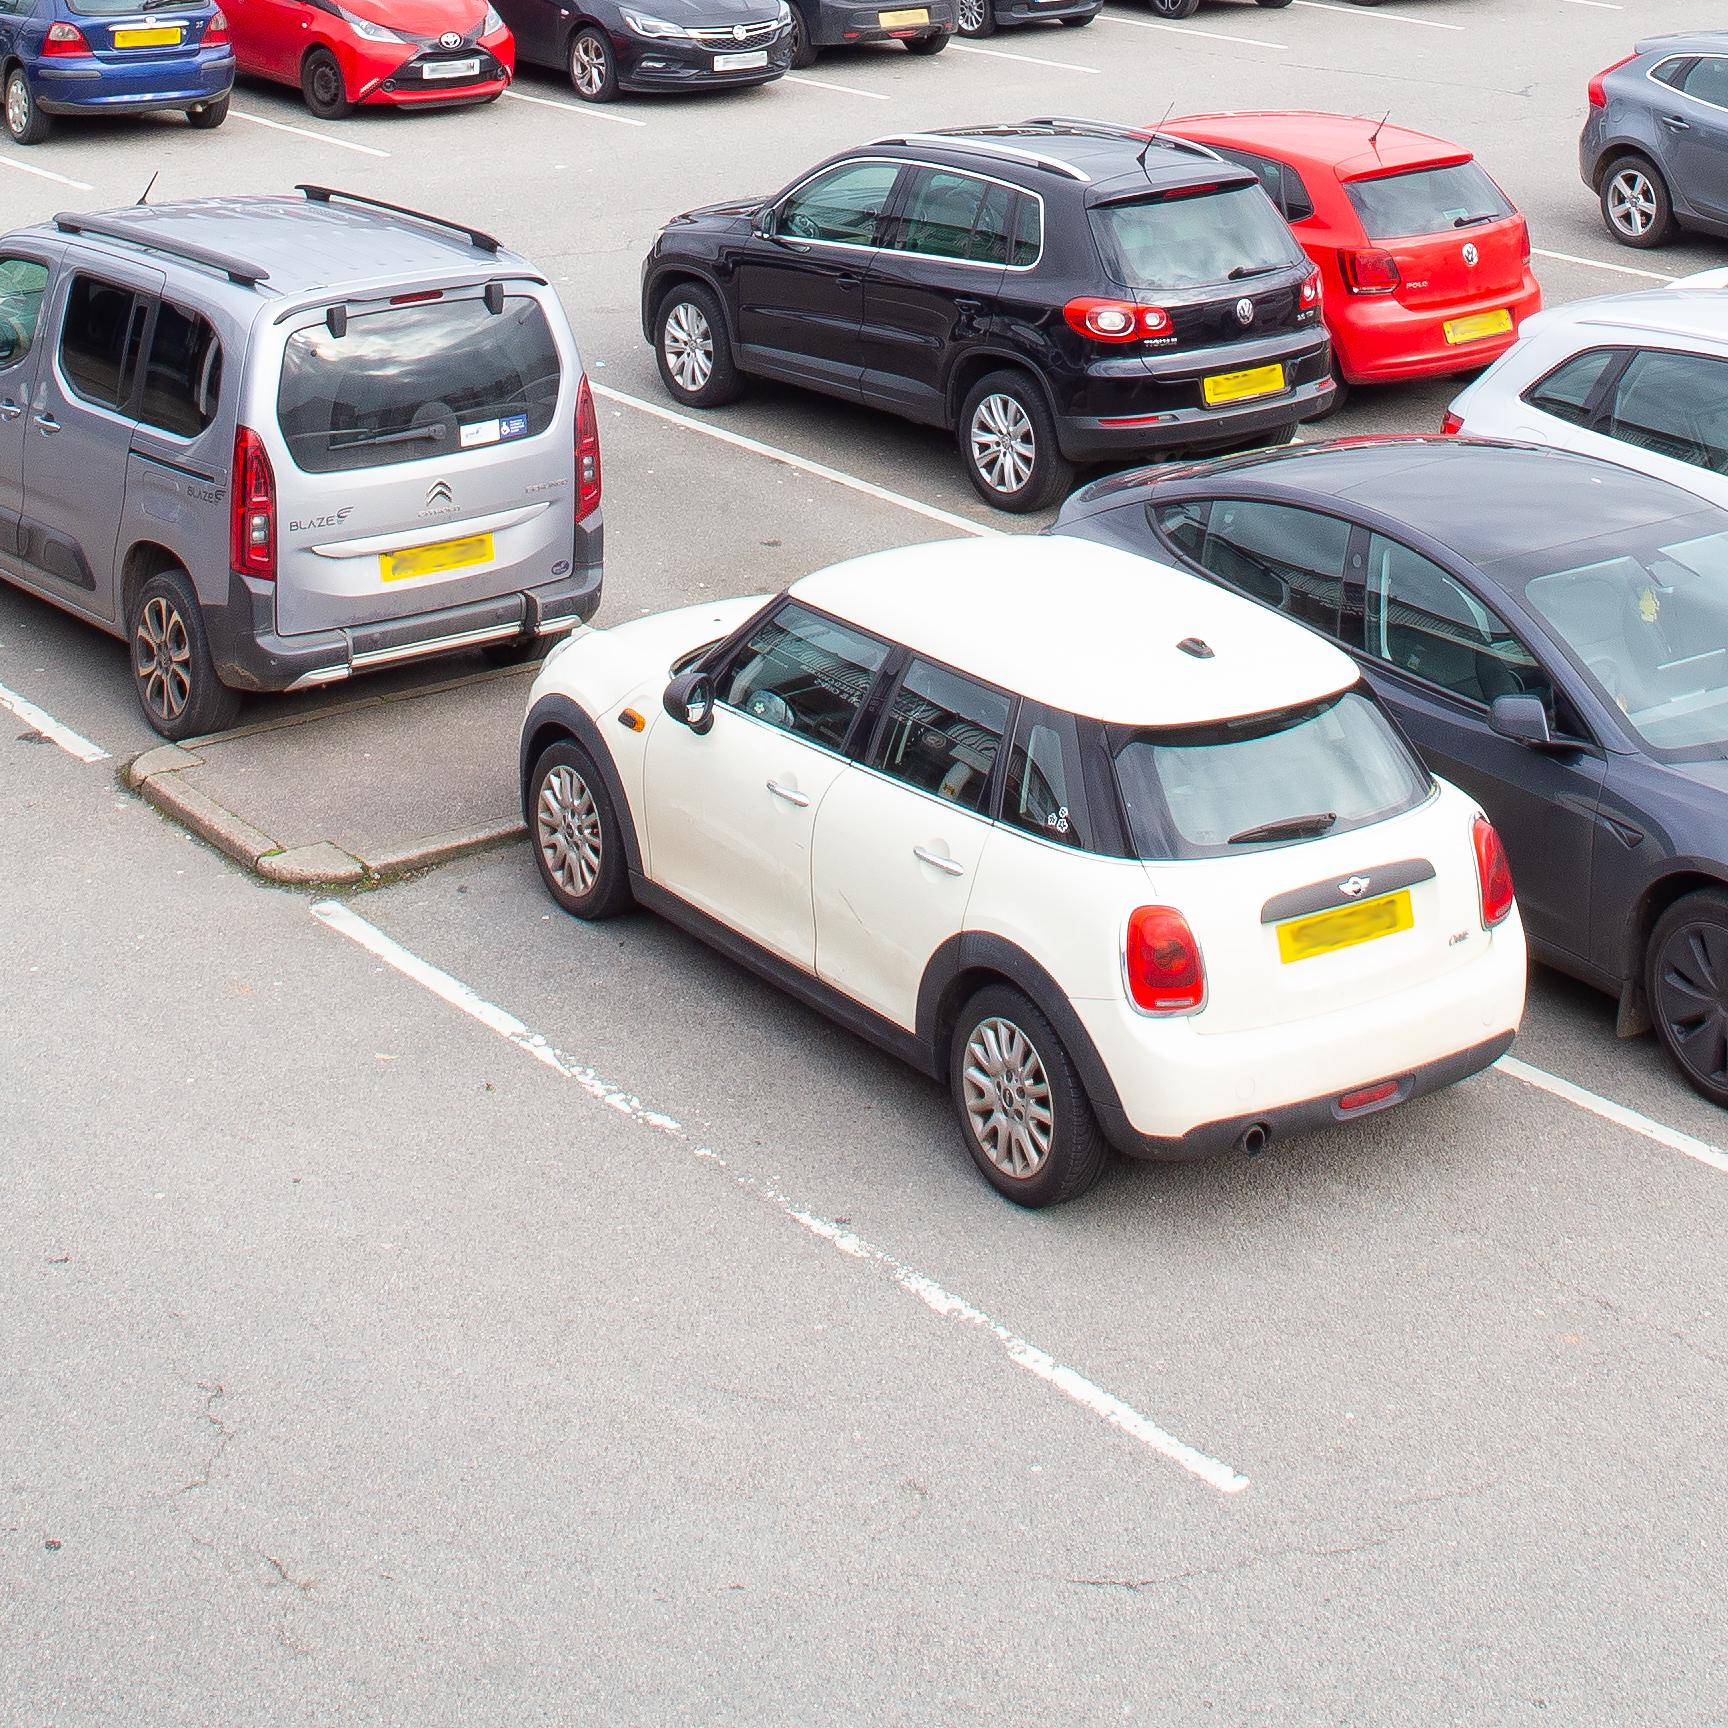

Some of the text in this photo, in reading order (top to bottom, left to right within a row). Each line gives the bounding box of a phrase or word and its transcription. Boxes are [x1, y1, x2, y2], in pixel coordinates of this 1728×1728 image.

[1405, 280, 1429, 289] POLO
[187, 486, 215, 503] BLAZE
[289, 516, 336, 532] BLAZE
